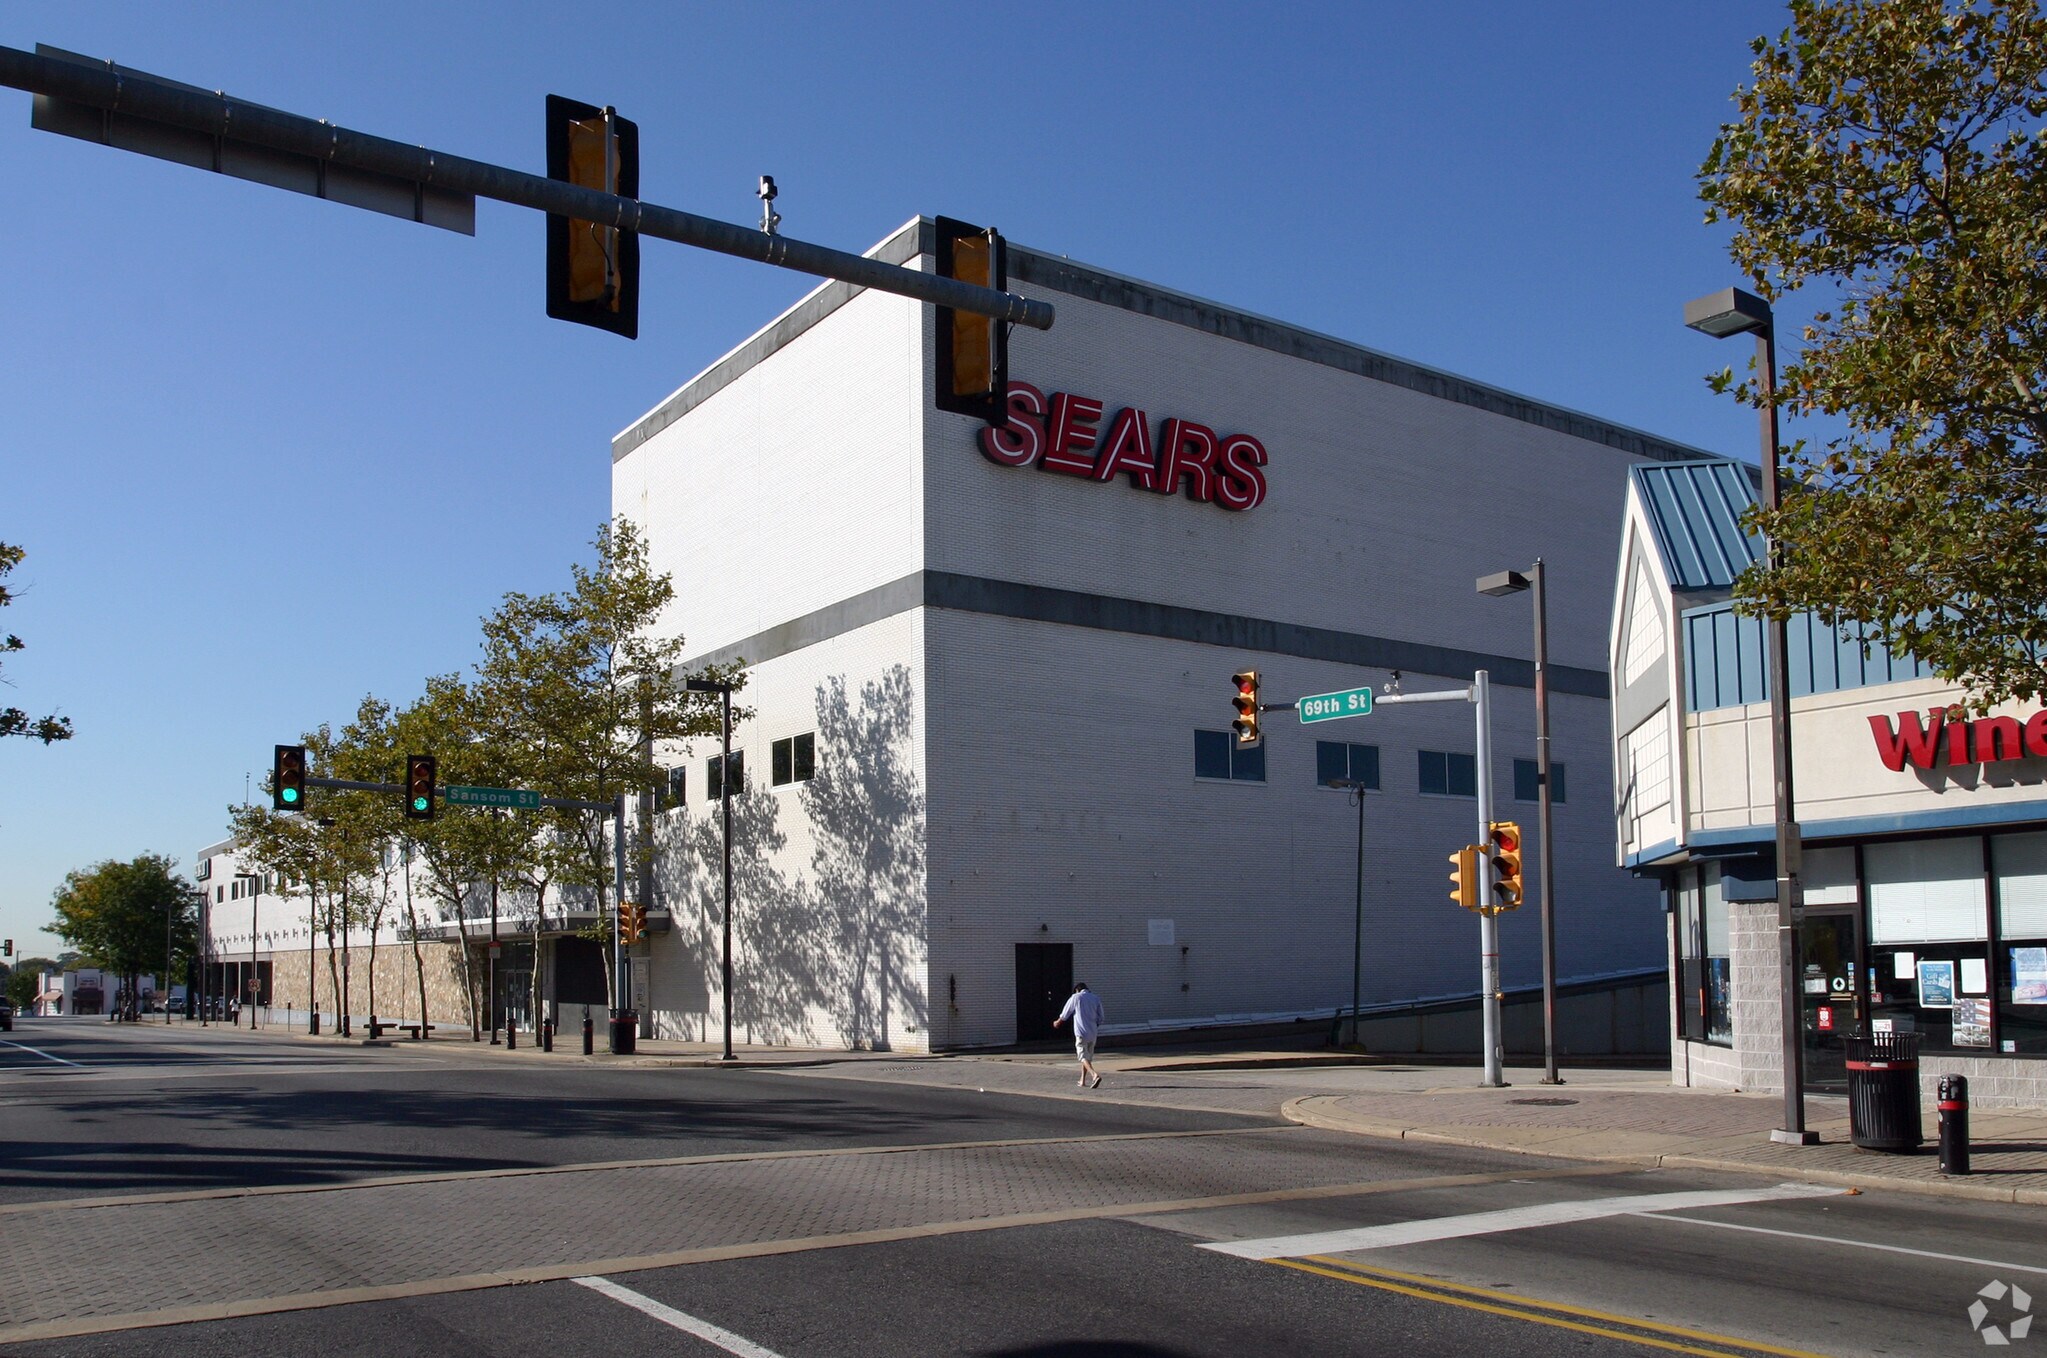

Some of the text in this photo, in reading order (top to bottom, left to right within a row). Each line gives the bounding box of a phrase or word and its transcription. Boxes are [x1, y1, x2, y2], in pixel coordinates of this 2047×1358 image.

[977, 380, 1268, 511] SEARS
[1304, 694, 1366, 716] 69th St
[450, 788, 534, 804] Sansom St
